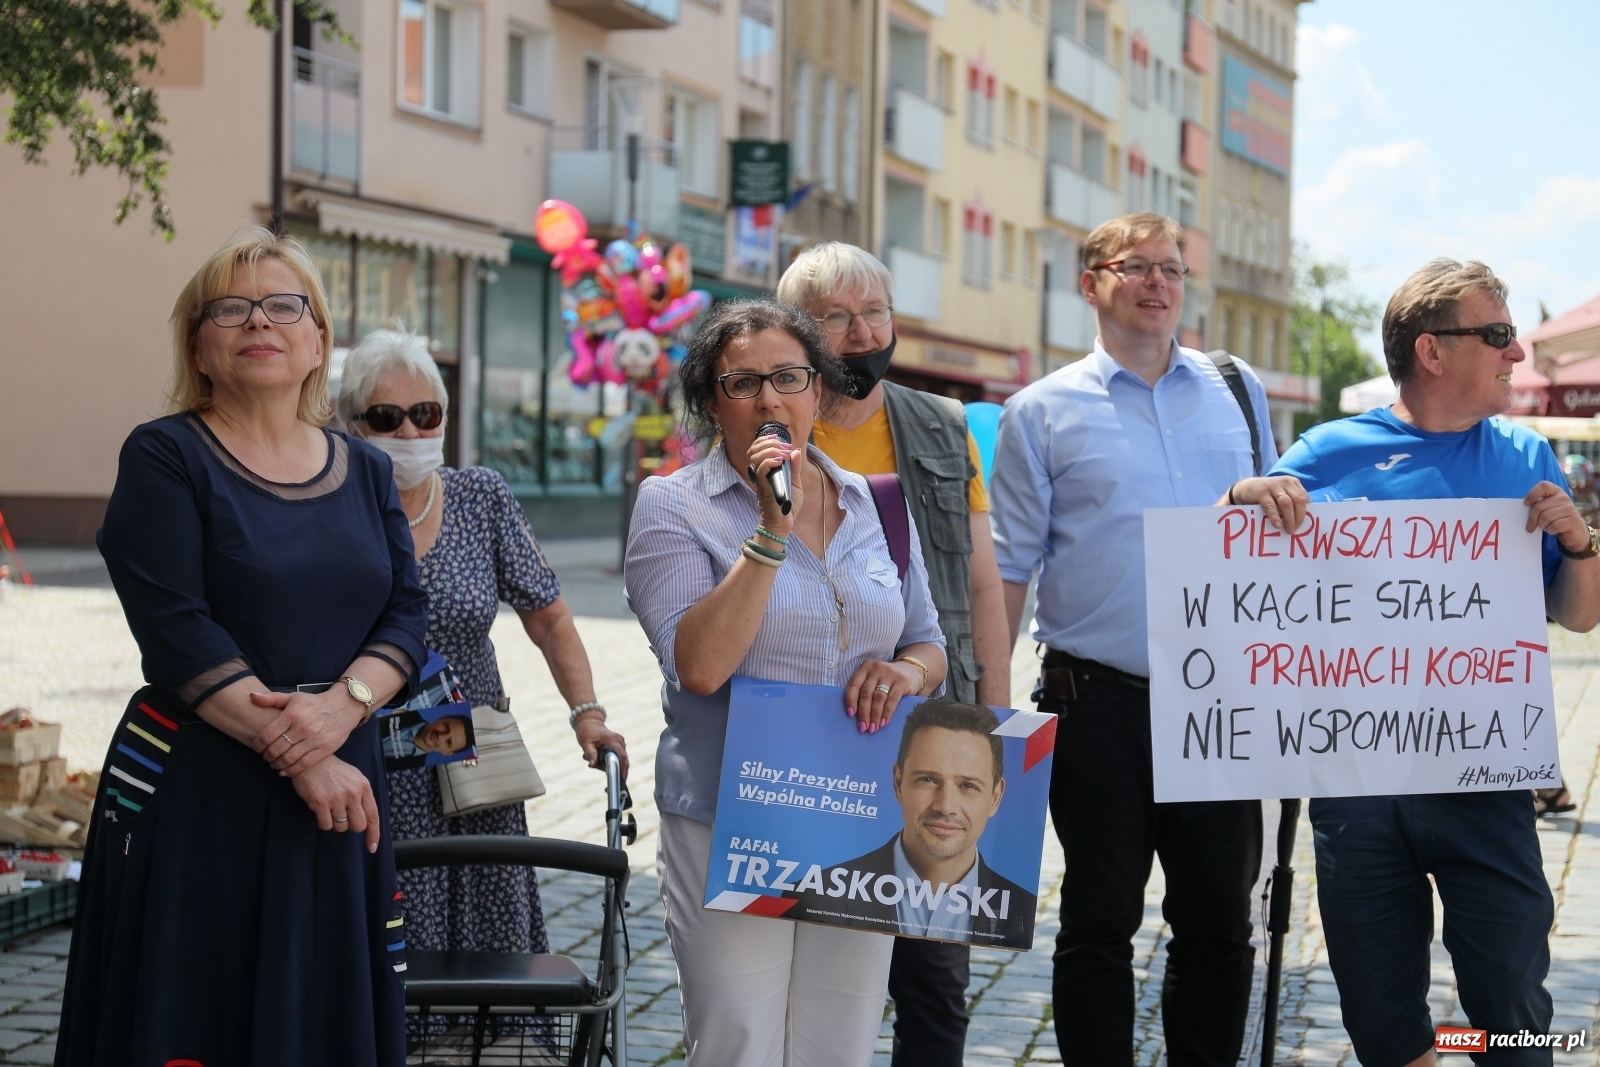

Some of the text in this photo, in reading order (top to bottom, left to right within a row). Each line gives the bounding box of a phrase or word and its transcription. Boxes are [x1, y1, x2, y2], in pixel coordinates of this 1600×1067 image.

[1217, 508, 1499, 563] PIERWSZA DAMA
[1183, 579, 1491, 630] W KĄCIE STAŁA
[1182, 640, 1548, 690] O PRAWACH KOBIET
[1183, 698, 1256, 761] NIE
[738, 782, 878, 817] Wspólna Polska
[740, 760, 878, 794] Silny Prezydent
[1457, 763, 1556, 787] #MamyDość
[730, 836, 779, 855] RAFAŁ
[726, 853, 1011, 920] TRZASKOWSKI
